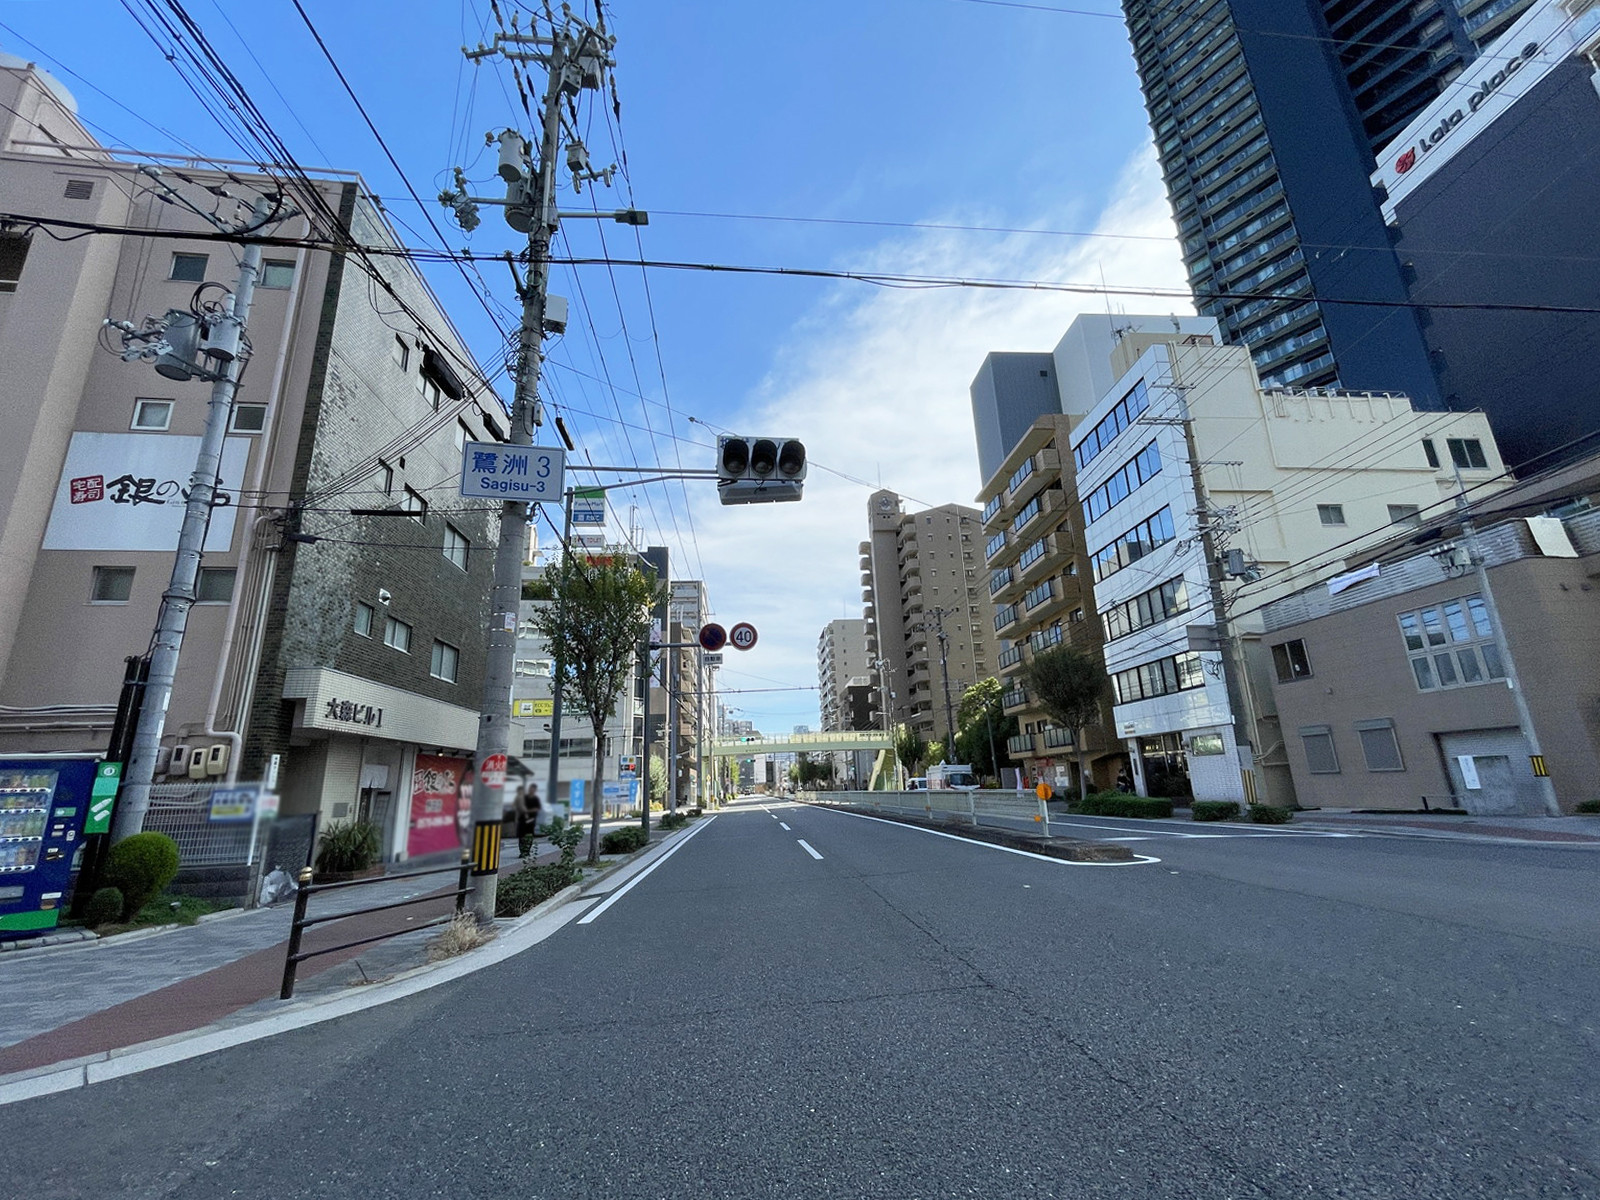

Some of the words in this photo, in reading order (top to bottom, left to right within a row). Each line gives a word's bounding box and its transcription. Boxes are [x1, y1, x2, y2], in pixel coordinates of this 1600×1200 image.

[1419, 109, 1464, 153] Lala
[1467, 41, 1540, 113] place
[471, 450, 529, 477] 鷺洲
[536, 456, 551, 478] 3
[72, 478, 102, 491] 宅配
[480, 477, 545, 493] Sagisu-3
[73, 489, 100, 503] 寿司
[736, 631, 752, 643] 40
